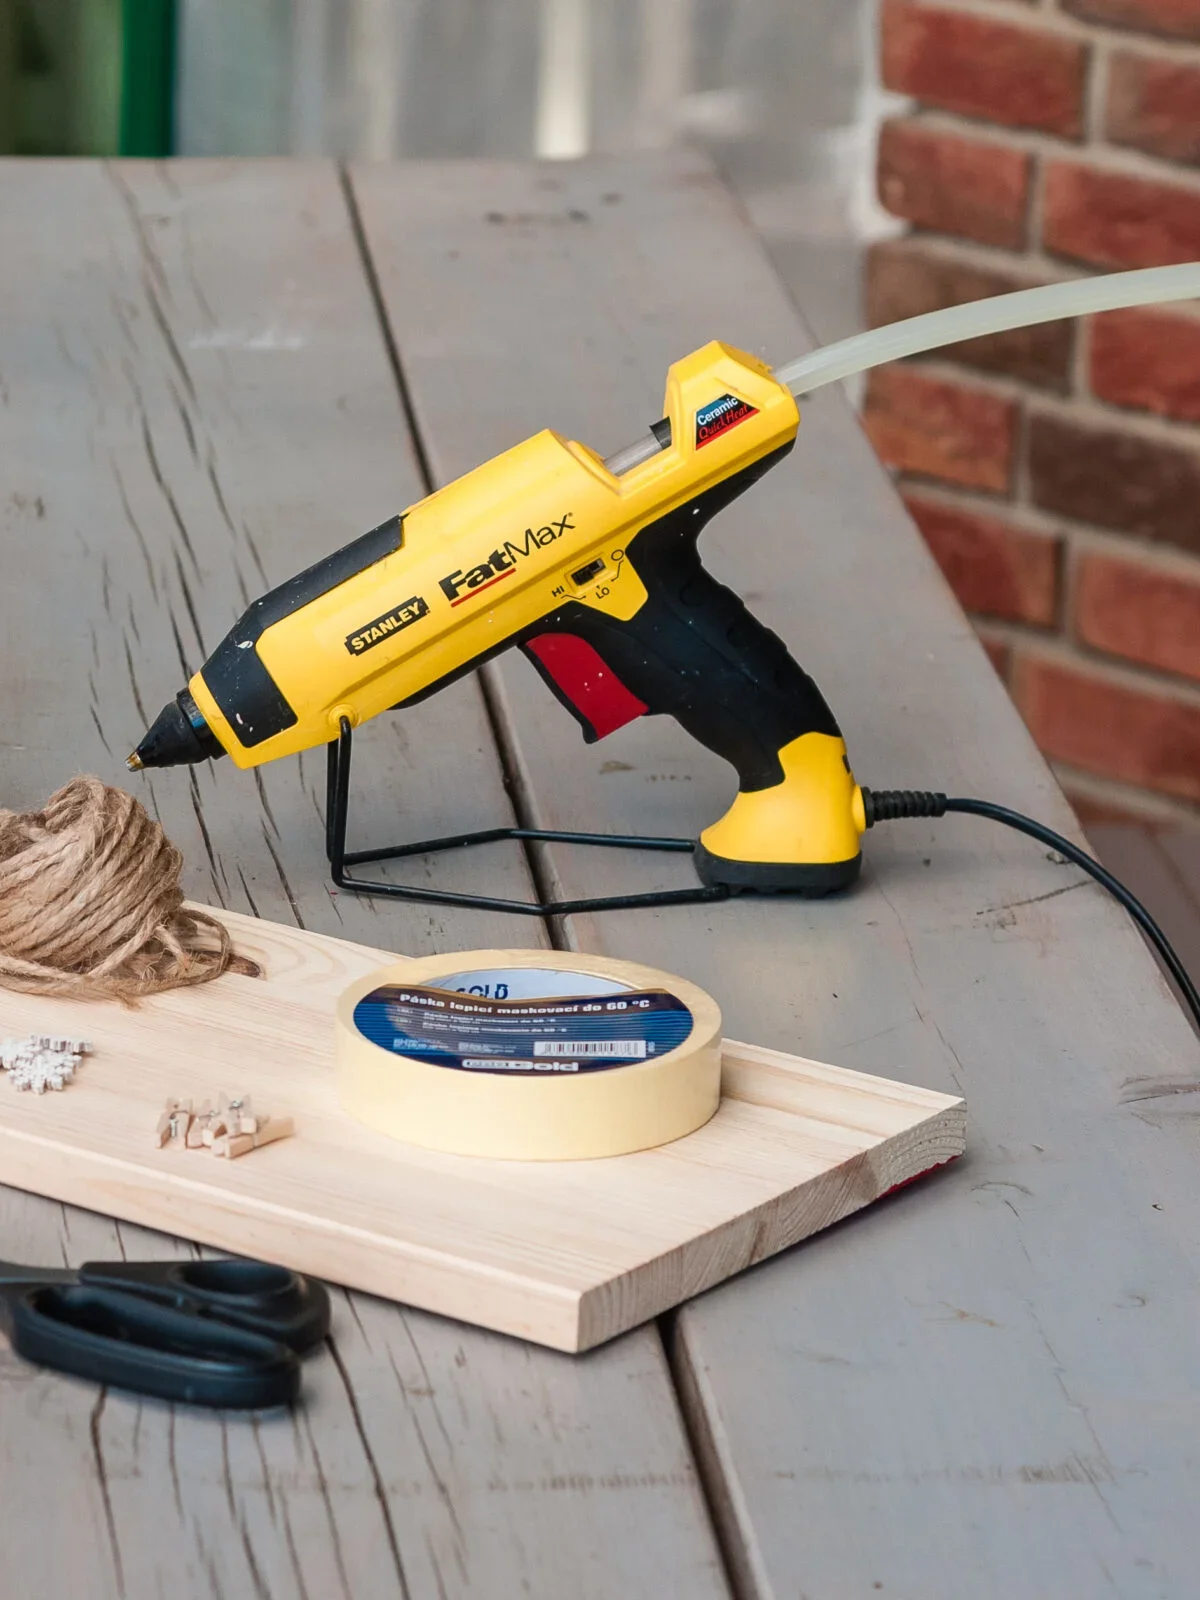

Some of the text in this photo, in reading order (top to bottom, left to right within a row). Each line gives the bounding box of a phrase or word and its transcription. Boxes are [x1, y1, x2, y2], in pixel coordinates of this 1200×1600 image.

[697, 397, 739, 425] Ceramic
[438, 516, 575, 601] FatMax
[551, 585, 565, 597] HI
[595, 587, 610, 599] LO
[350, 600, 422, 651] STANLEY
[400, 993, 445, 1008] Páska
[449, 1001, 493, 1014] lepicí
[497, 1004, 579, 1014] maskovací
[582, 1004, 602, 1012] do
[606, 1001, 627, 1010] 60
